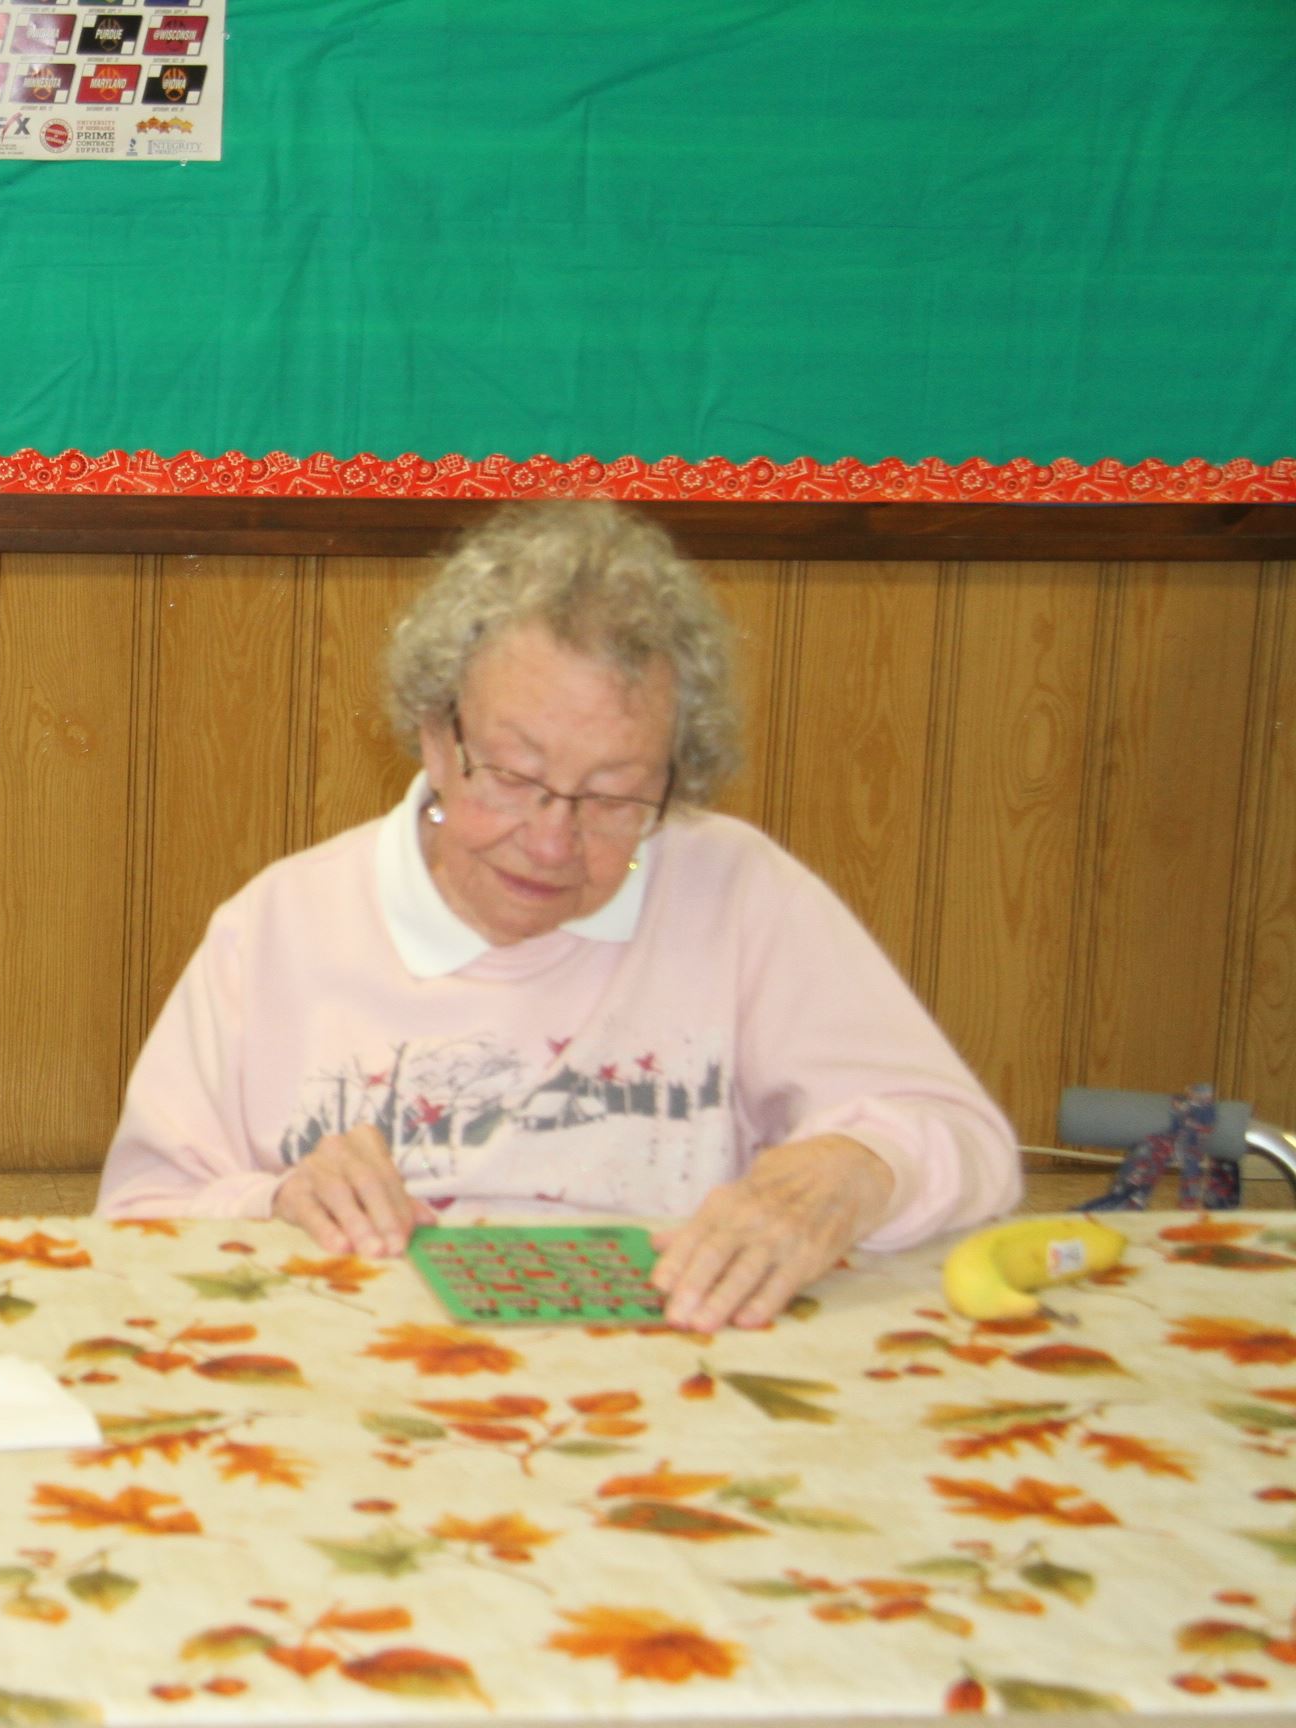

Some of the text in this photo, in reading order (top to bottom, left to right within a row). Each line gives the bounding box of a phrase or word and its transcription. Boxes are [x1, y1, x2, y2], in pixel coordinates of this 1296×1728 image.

[94, 29, 124, 40] PURDUE
[90, 78, 127, 89] MARYLAND
[76, 132, 116, 140] PRIME
